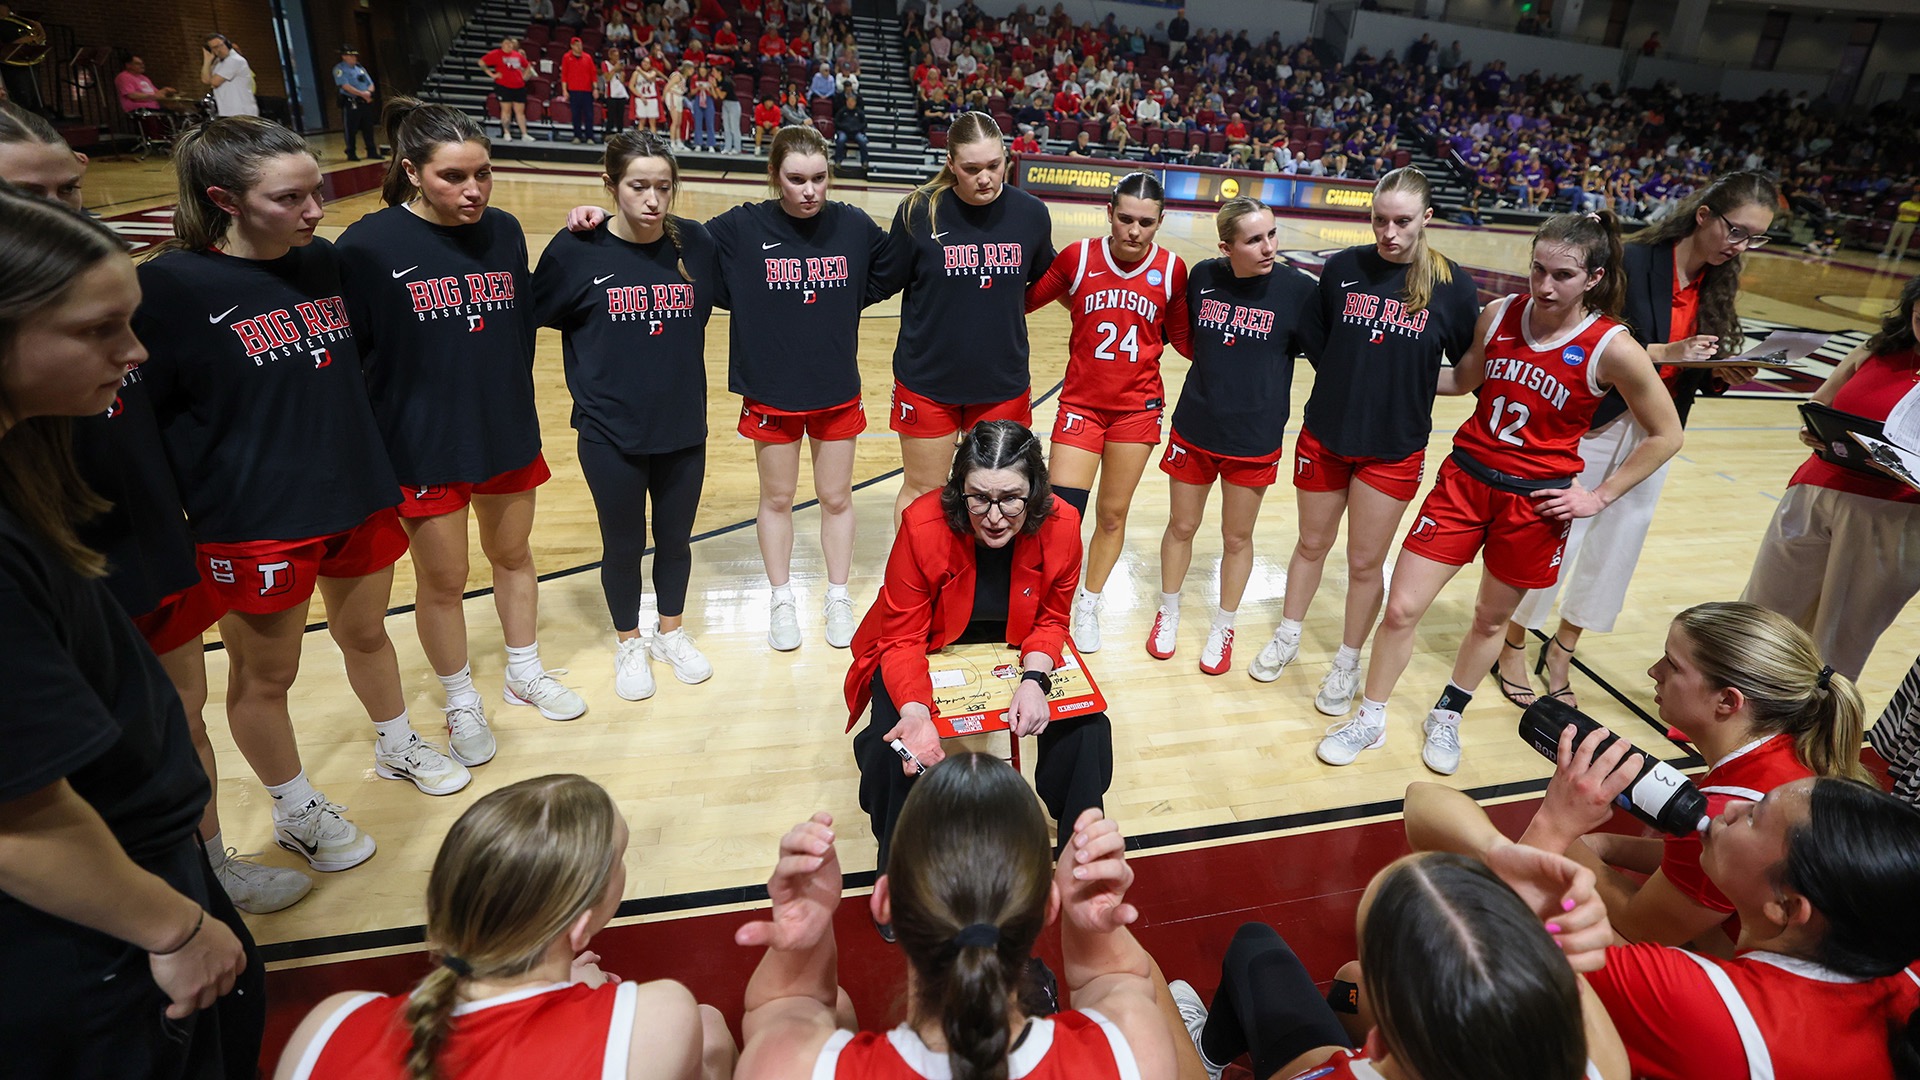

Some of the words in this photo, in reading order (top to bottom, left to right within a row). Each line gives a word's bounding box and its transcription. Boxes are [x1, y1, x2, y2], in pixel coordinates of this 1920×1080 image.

[1027, 166, 1111, 188] CHAMPIONS
[1325, 189, 1374, 208] CHAMPI
[765, 258, 802, 282] BIG
[806, 256, 849, 281] RED
[944, 244, 979, 269] BIG
[983, 243, 1022, 267] RED
[947, 266, 1020, 276] BASKETBALL
[406, 276, 463, 313] BIG
[464, 271, 515, 303] RED
[768, 280, 847, 290] BASKETBALL
[418, 300, 515, 321] BASKETBALL
[606, 286, 648, 314] BIG
[651, 284, 695, 311] RED
[1084, 289, 1158, 324] DENISON
[611, 310, 693, 321] BASKETBALL
[1198, 299, 1231, 324] BIG
[1230, 306, 1275, 333] RED
[1343, 292, 1380, 319] BIG
[1380, 298, 1430, 333] RED
[230, 309, 302, 357] BIG
[294, 296, 350, 337] RED
[1342, 315, 1420, 340] BASKETBALL
[1094, 321, 1139, 363] 24
[1485, 358, 1571, 411] DENISON
[1489, 395, 1531, 447] 12
[210, 557, 236, 583] ED
[1653, 769, 1677, 788] 3
